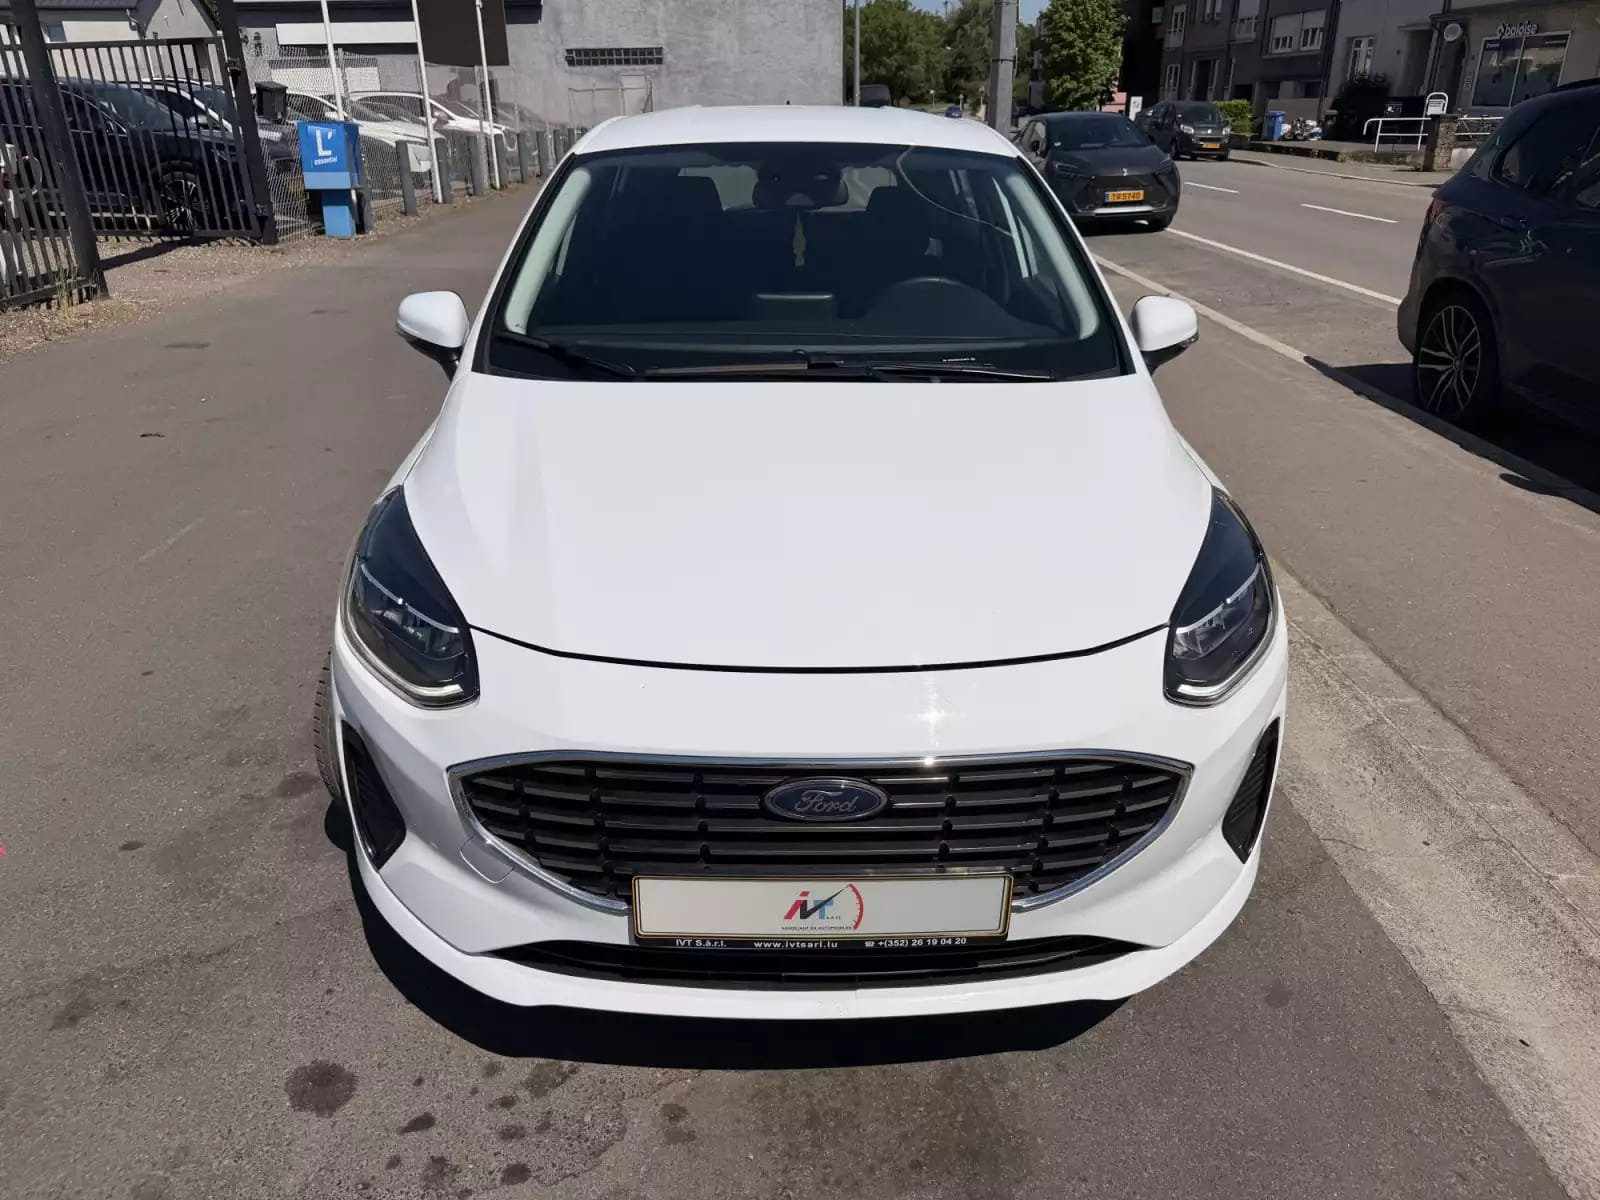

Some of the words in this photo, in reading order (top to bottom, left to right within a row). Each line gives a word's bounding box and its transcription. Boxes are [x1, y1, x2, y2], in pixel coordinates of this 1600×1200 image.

[1505, 21, 1538, 37] baloise
[794, 789, 859, 813] Ford
[676, 939, 693, 947] IVT
[753, 941, 838, 949] www.ivtsarl.lu
[878, 939, 909, 948] +(352)
[926, 938, 938, 946] 19
[955, 937, 967, 945] 20
